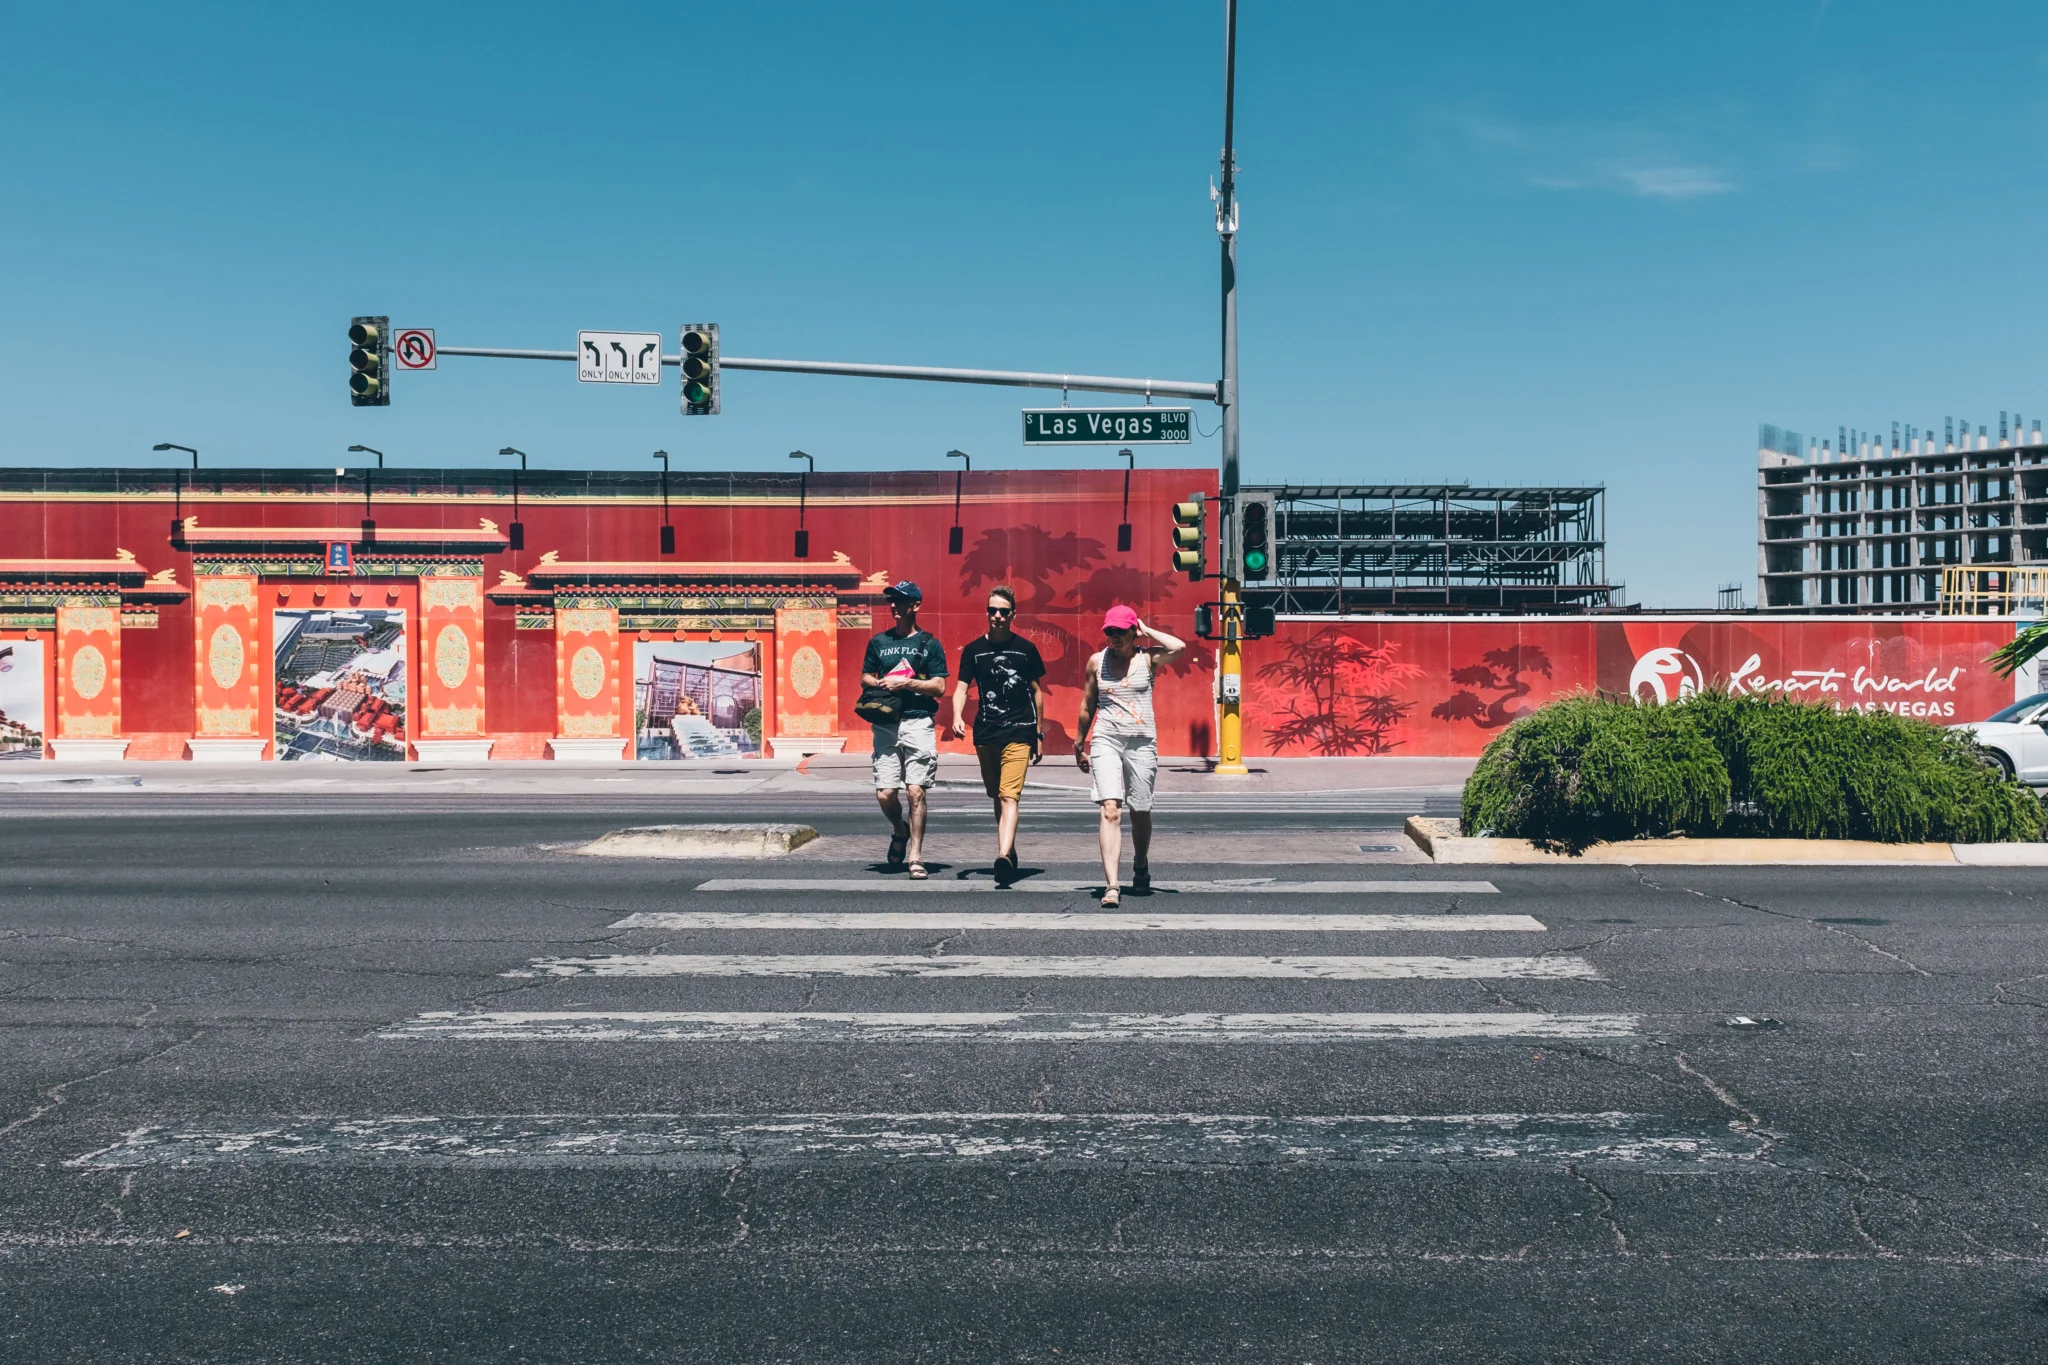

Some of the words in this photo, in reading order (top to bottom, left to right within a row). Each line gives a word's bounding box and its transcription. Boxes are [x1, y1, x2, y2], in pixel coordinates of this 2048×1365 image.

[581, 369, 603, 379] ONLY
[608, 370, 630, 380] ONLY
[635, 371, 656, 381] ONLY
[1026, 414, 1033, 424] S
[1039, 414, 1077, 435] Las
[1087, 413, 1153, 440] Vegas
[1160, 413, 1186, 423] BLVD
[1160, 429, 1187, 440] 3000
[880, 646, 900, 657] PINK
[901, 646, 929, 657] FLOD
[1883, 701, 1955, 717] VEGAS
